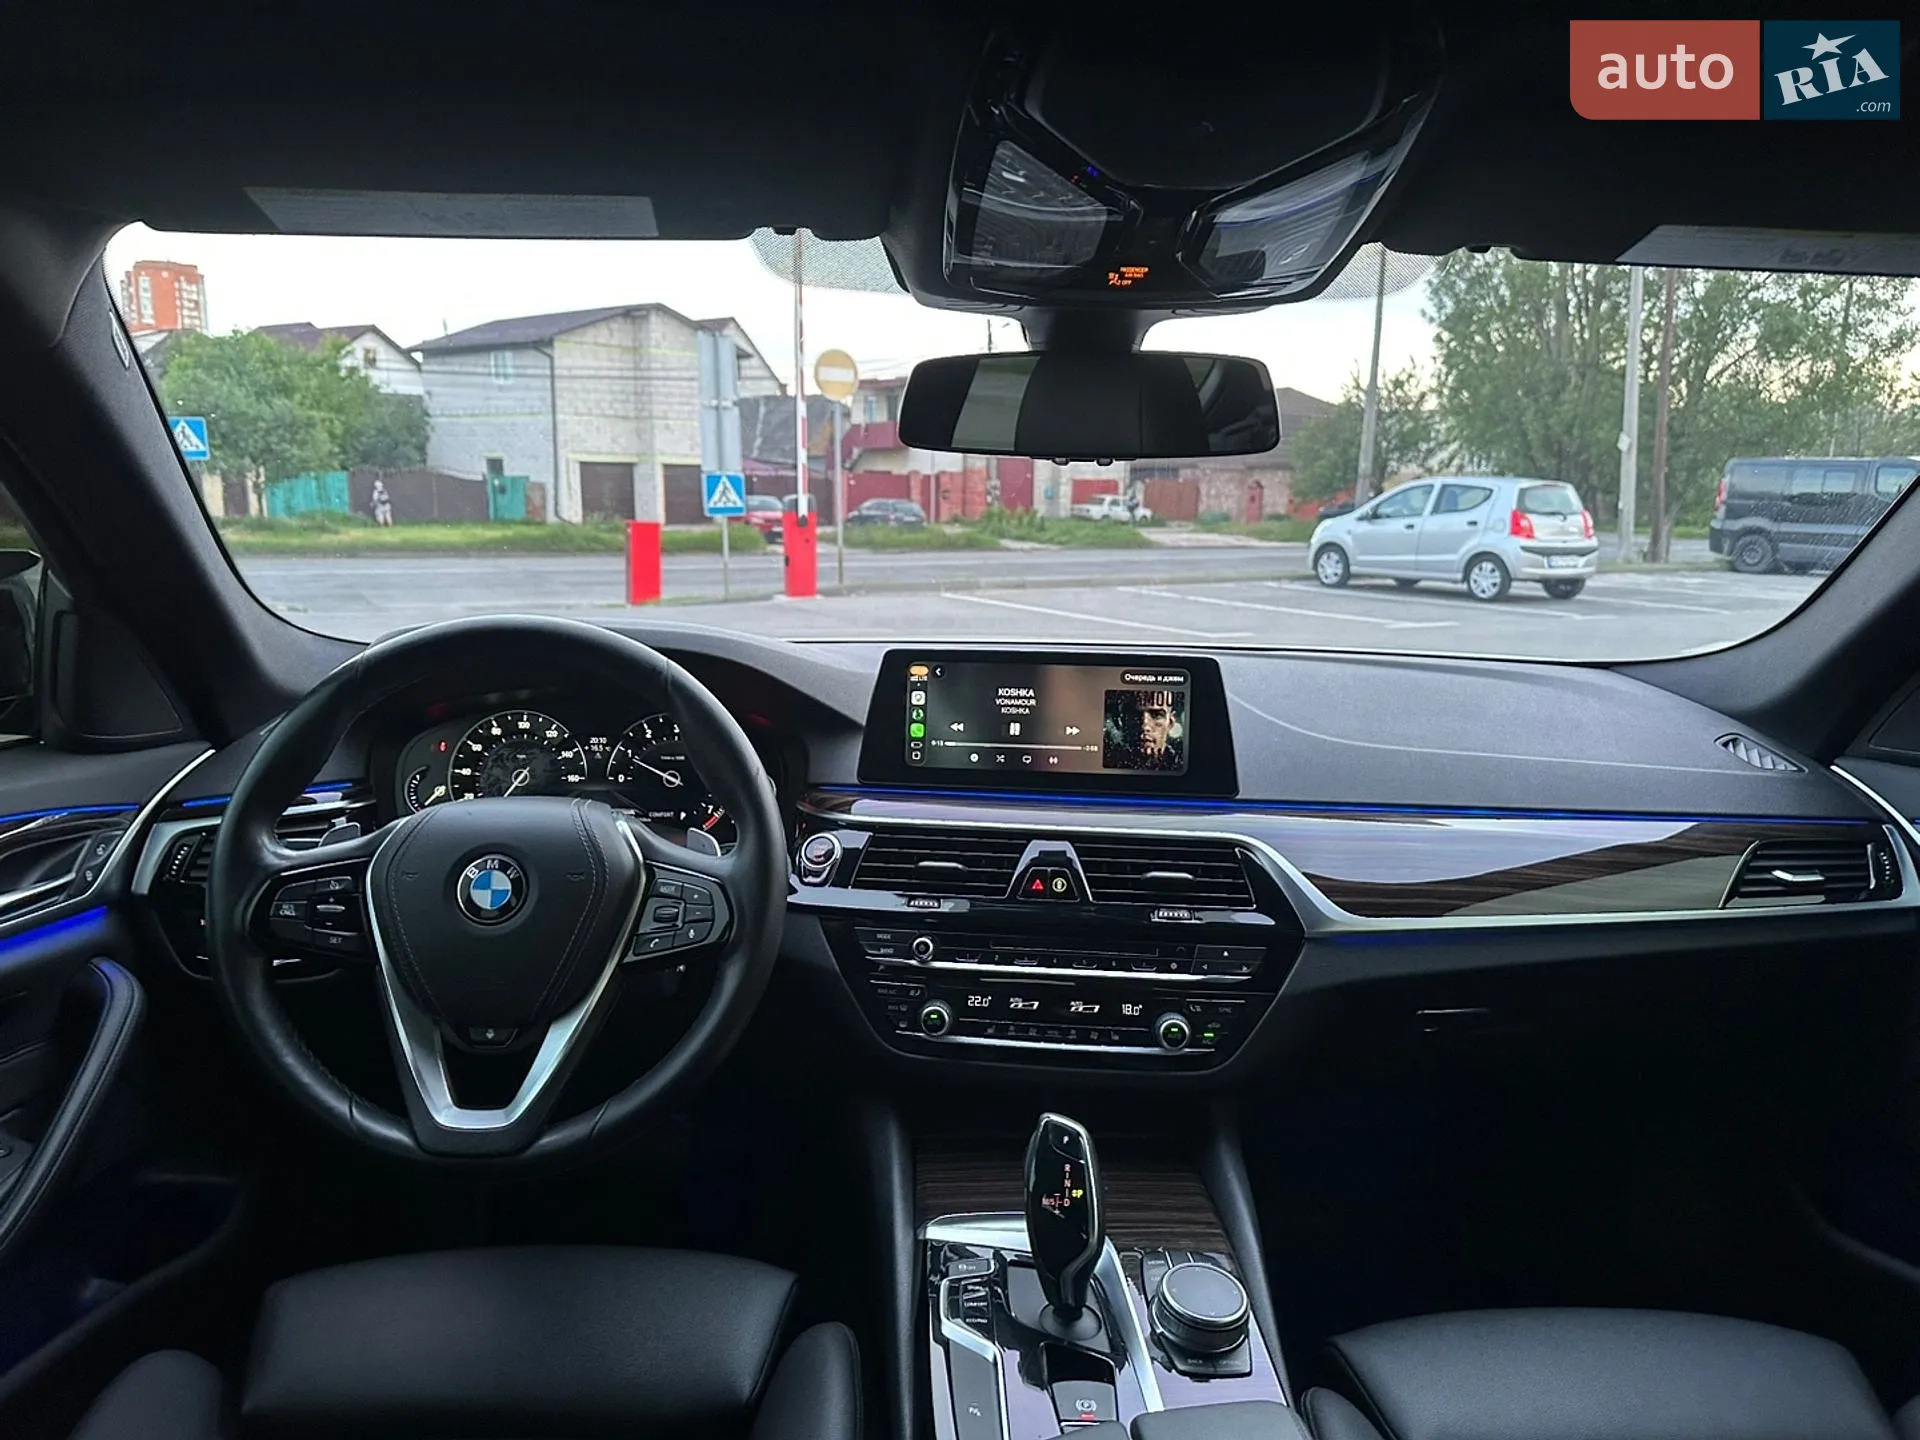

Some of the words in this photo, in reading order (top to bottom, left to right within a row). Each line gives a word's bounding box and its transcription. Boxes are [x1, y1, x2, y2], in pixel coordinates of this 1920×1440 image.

[998, 688, 1035, 698] KOSHKA
[995, 698, 1037, 707] VONAMOUR
[1001, 706, 1031, 715] KOSHKA
[518, 721, 530, 730] 100
[645, 728, 653, 739] 2
[617, 773, 625, 783] 0
[1063, 1135, 1070, 1145] P
